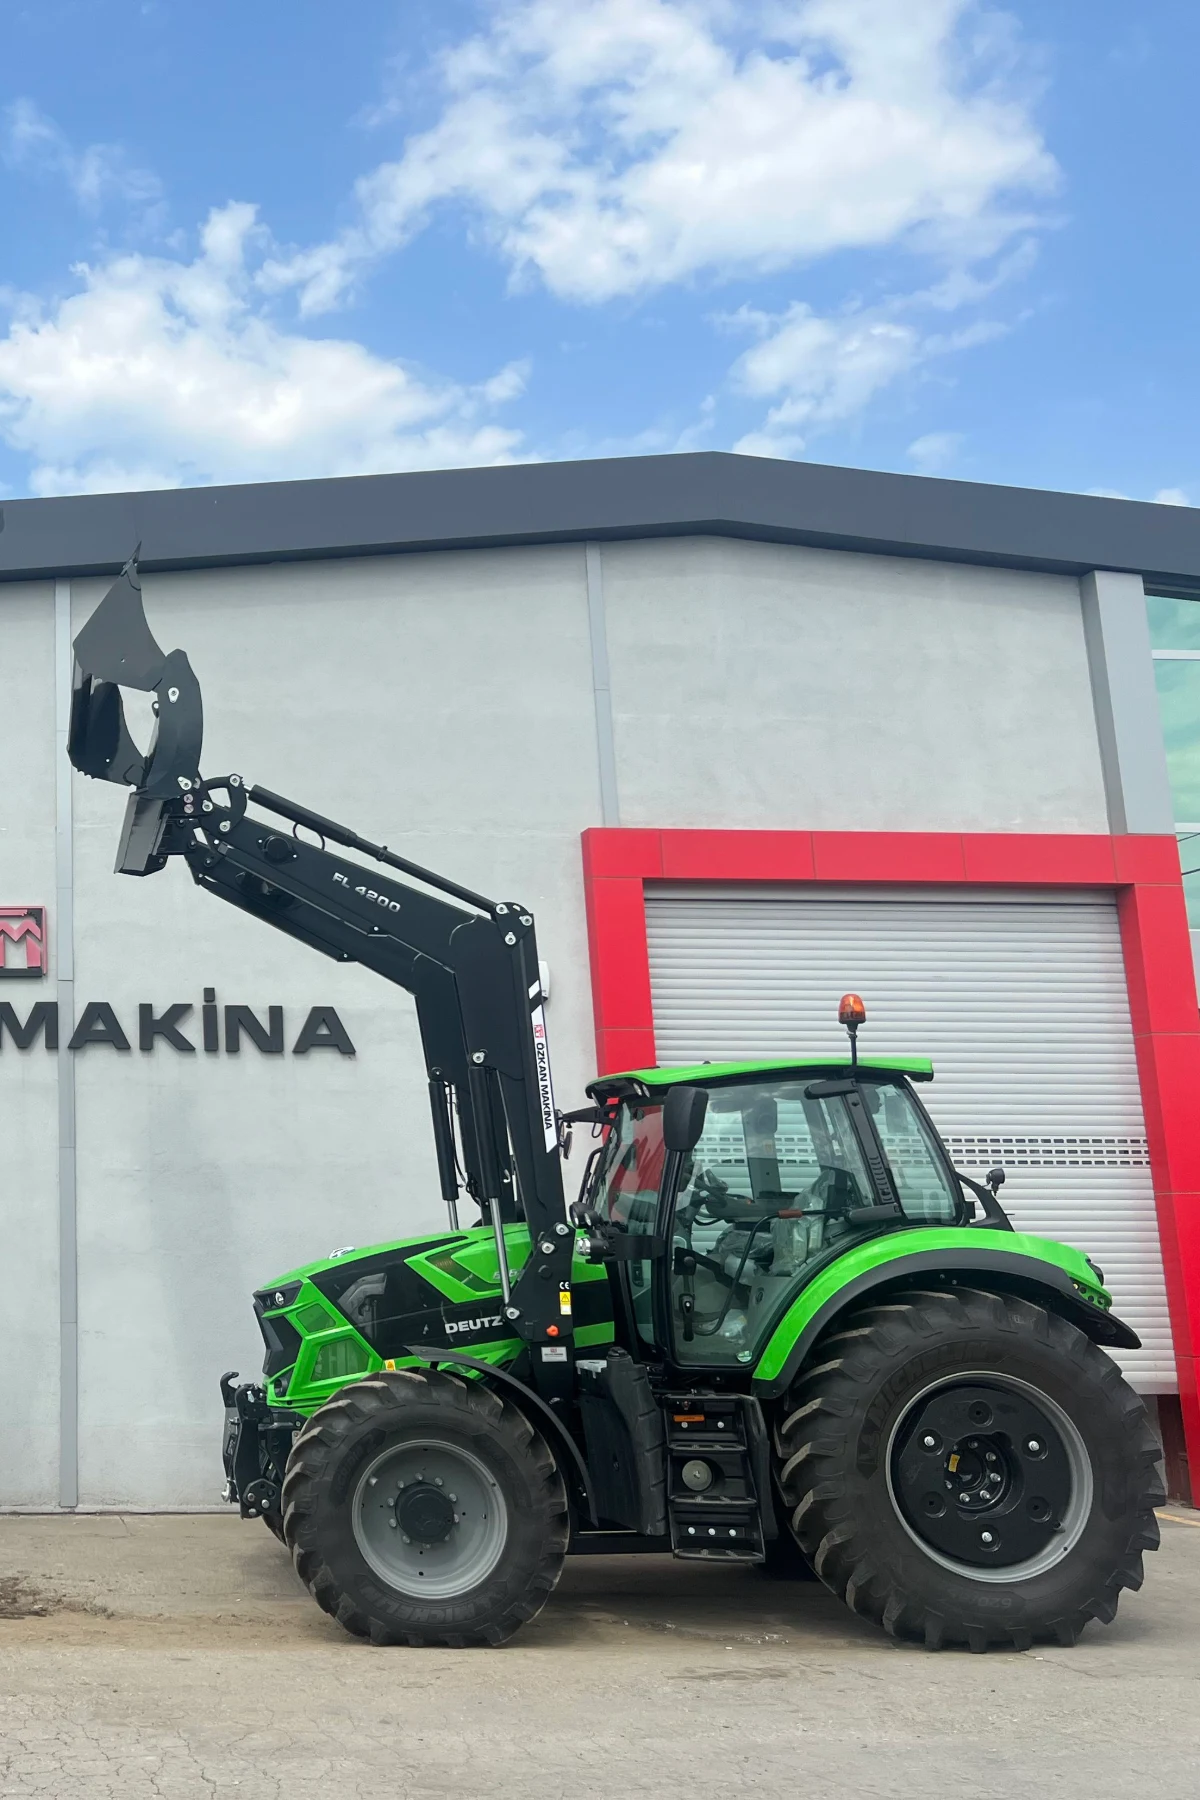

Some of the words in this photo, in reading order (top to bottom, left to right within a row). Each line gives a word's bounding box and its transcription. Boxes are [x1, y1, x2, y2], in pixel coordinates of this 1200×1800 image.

[332, 872, 351, 889] FL
[354, 886, 401, 913] 4200
[536, 1042, 548, 1082] ÖZKAN
[540, 1084, 553, 1130] MAKİNA
[444, 1315, 503, 1334] DEUTZ
